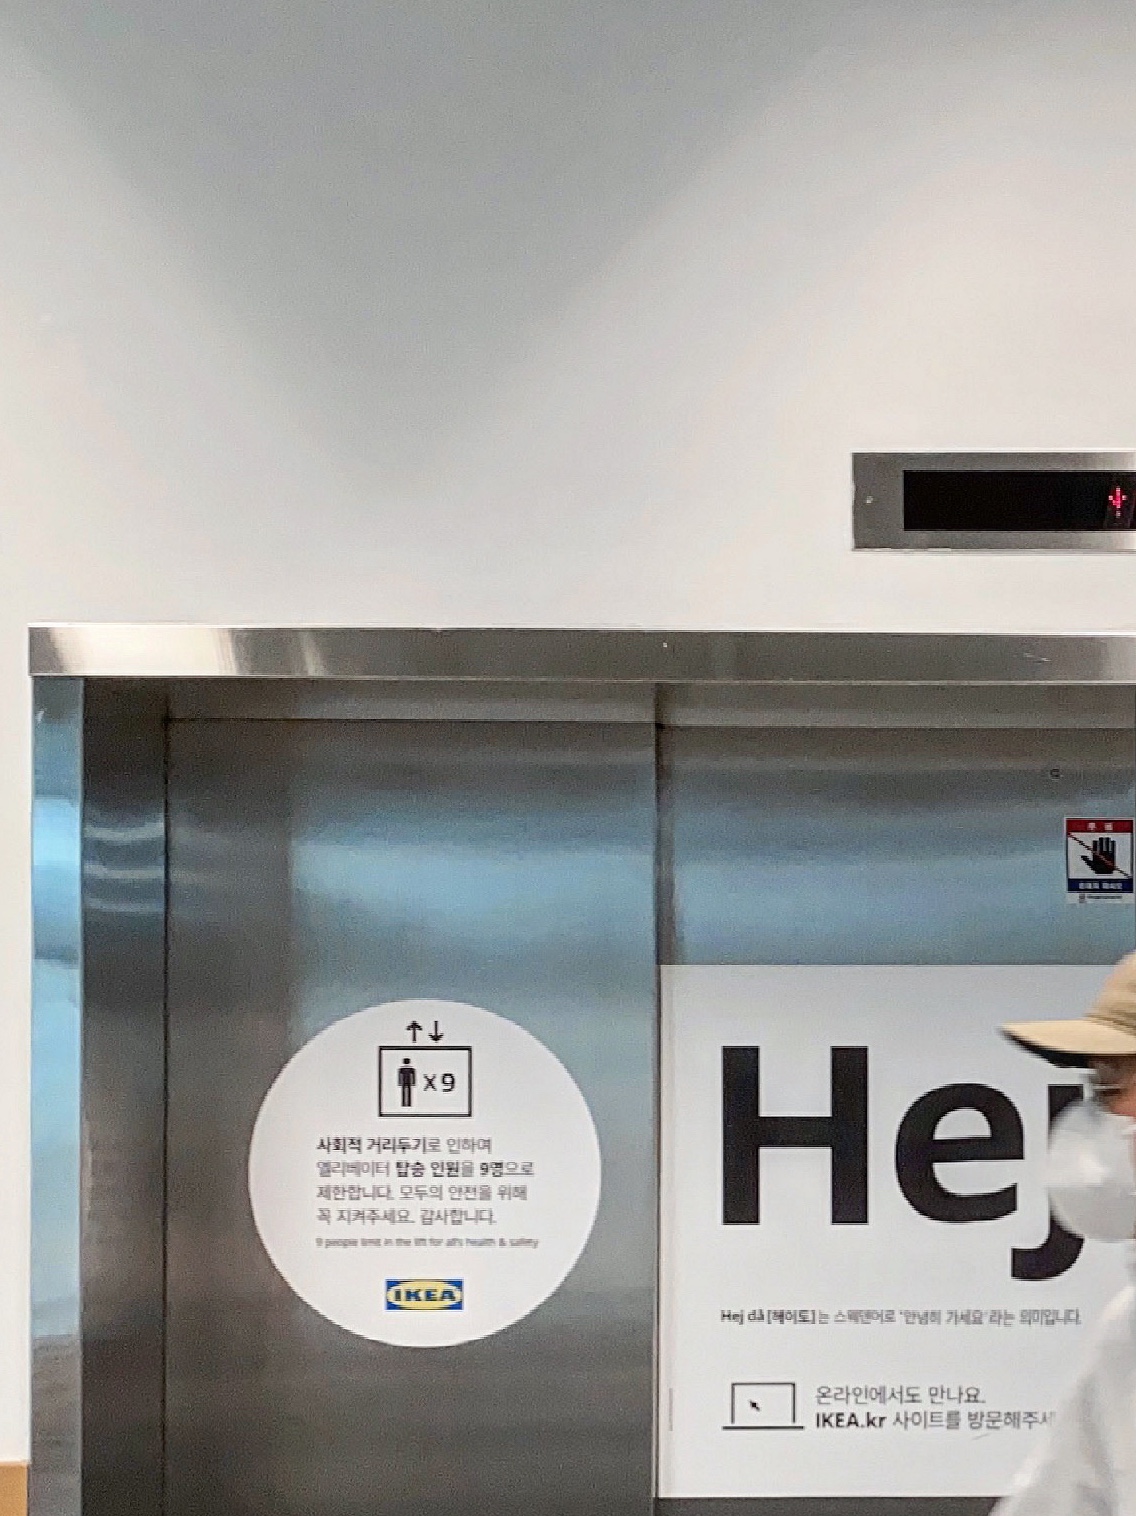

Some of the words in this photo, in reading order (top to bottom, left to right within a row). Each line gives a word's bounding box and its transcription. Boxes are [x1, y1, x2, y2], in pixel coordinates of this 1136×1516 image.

[316, 1136, 362, 1155] 사회적
[366, 1136, 441, 1155] 거리두기로
[446, 1136, 492, 1155] 인하여
[396, 1160, 425, 1178] 탑승
[430, 1160, 473, 1178] 인원을
[480, 1160, 535, 1178] 9명으로
[316, 1184, 394, 1201] 제한합니다.
[399, 1184, 443, 1201] 모두의
[448, 1184, 492, 1201] 안전을
[497, 1183, 528, 1201] 위해
[316, 1207, 331, 1226] 꼭
[420, 1207, 497, 1226] 감사합니다.
[394, 1289, 456, 1302] IKEA
[720, 1309, 744, 1325] Hej
[815, 1385, 923, 1405] 온라인에서도
[928, 1385, 986, 1405] 만나요.
[815, 1411, 887, 1429] IKEA.kr
[892, 1410, 962, 1430] 사이트를
